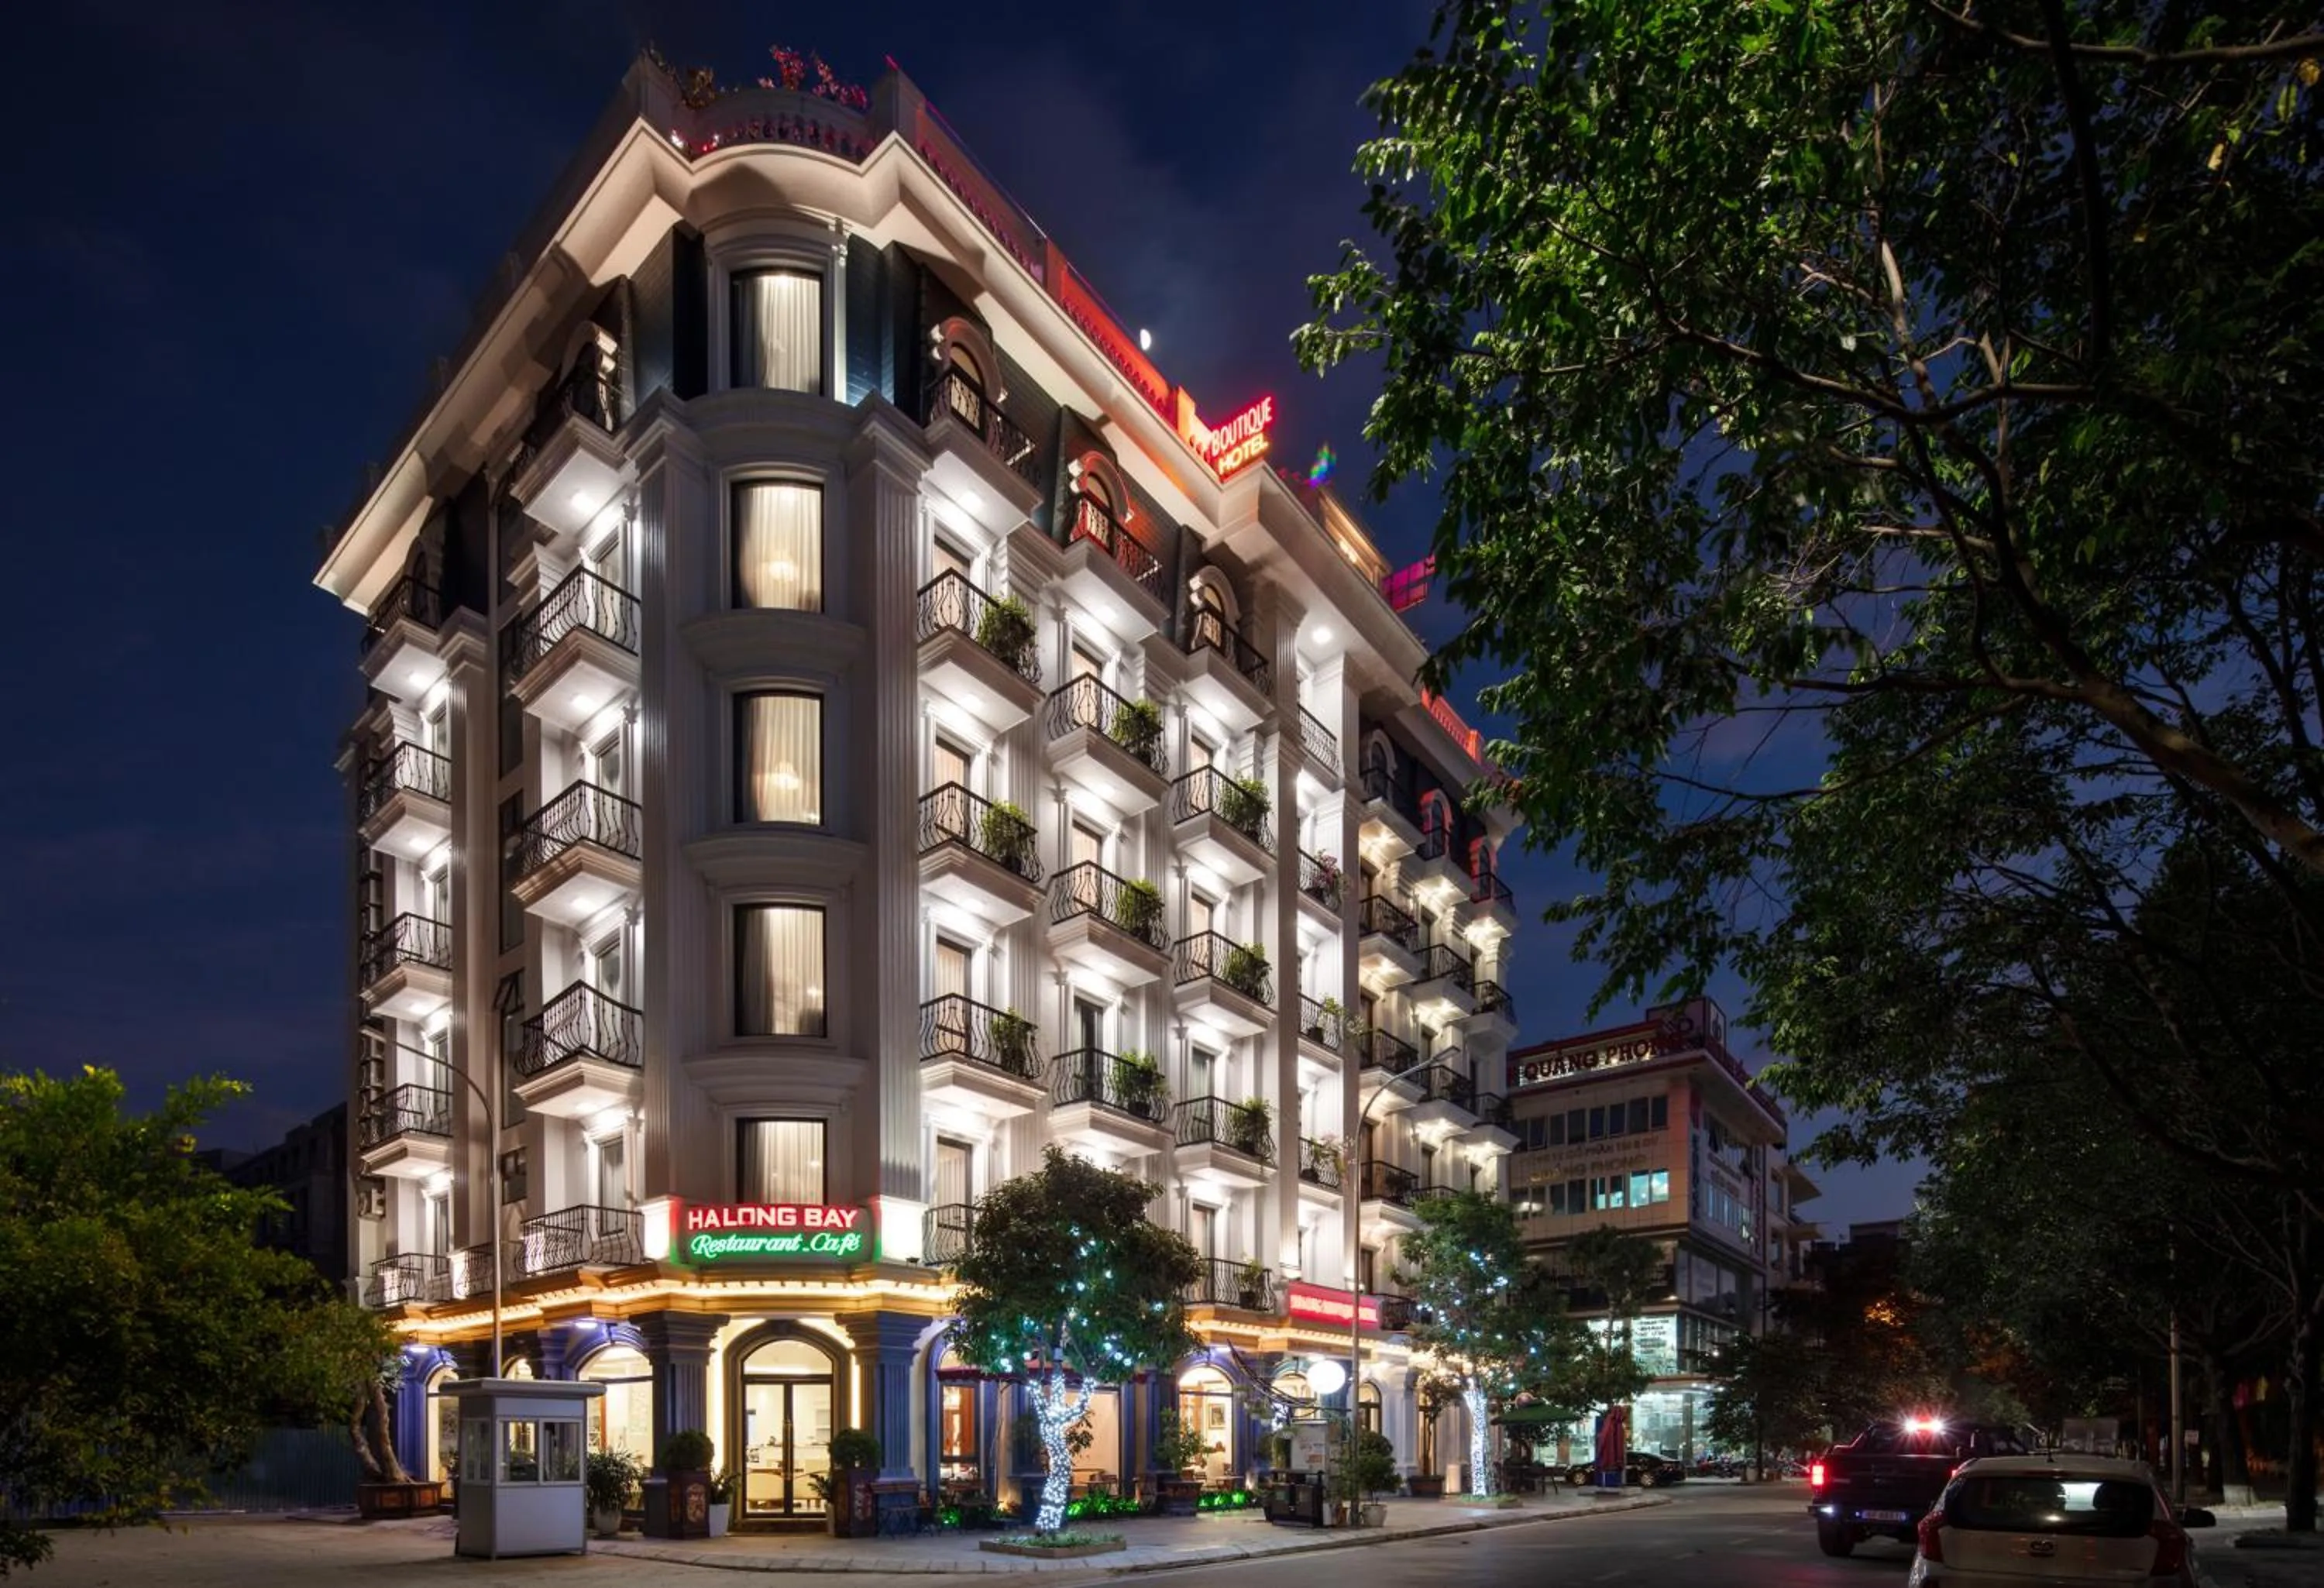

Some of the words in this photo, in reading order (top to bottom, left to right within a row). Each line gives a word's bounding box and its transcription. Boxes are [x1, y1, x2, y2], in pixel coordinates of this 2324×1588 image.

[1211, 396, 1273, 457] BOUTIQUE
[1218, 433, 1269, 475] HOTEL
[688, 1207, 797, 1230] HALONG
[804, 1208, 858, 1229] BAY
